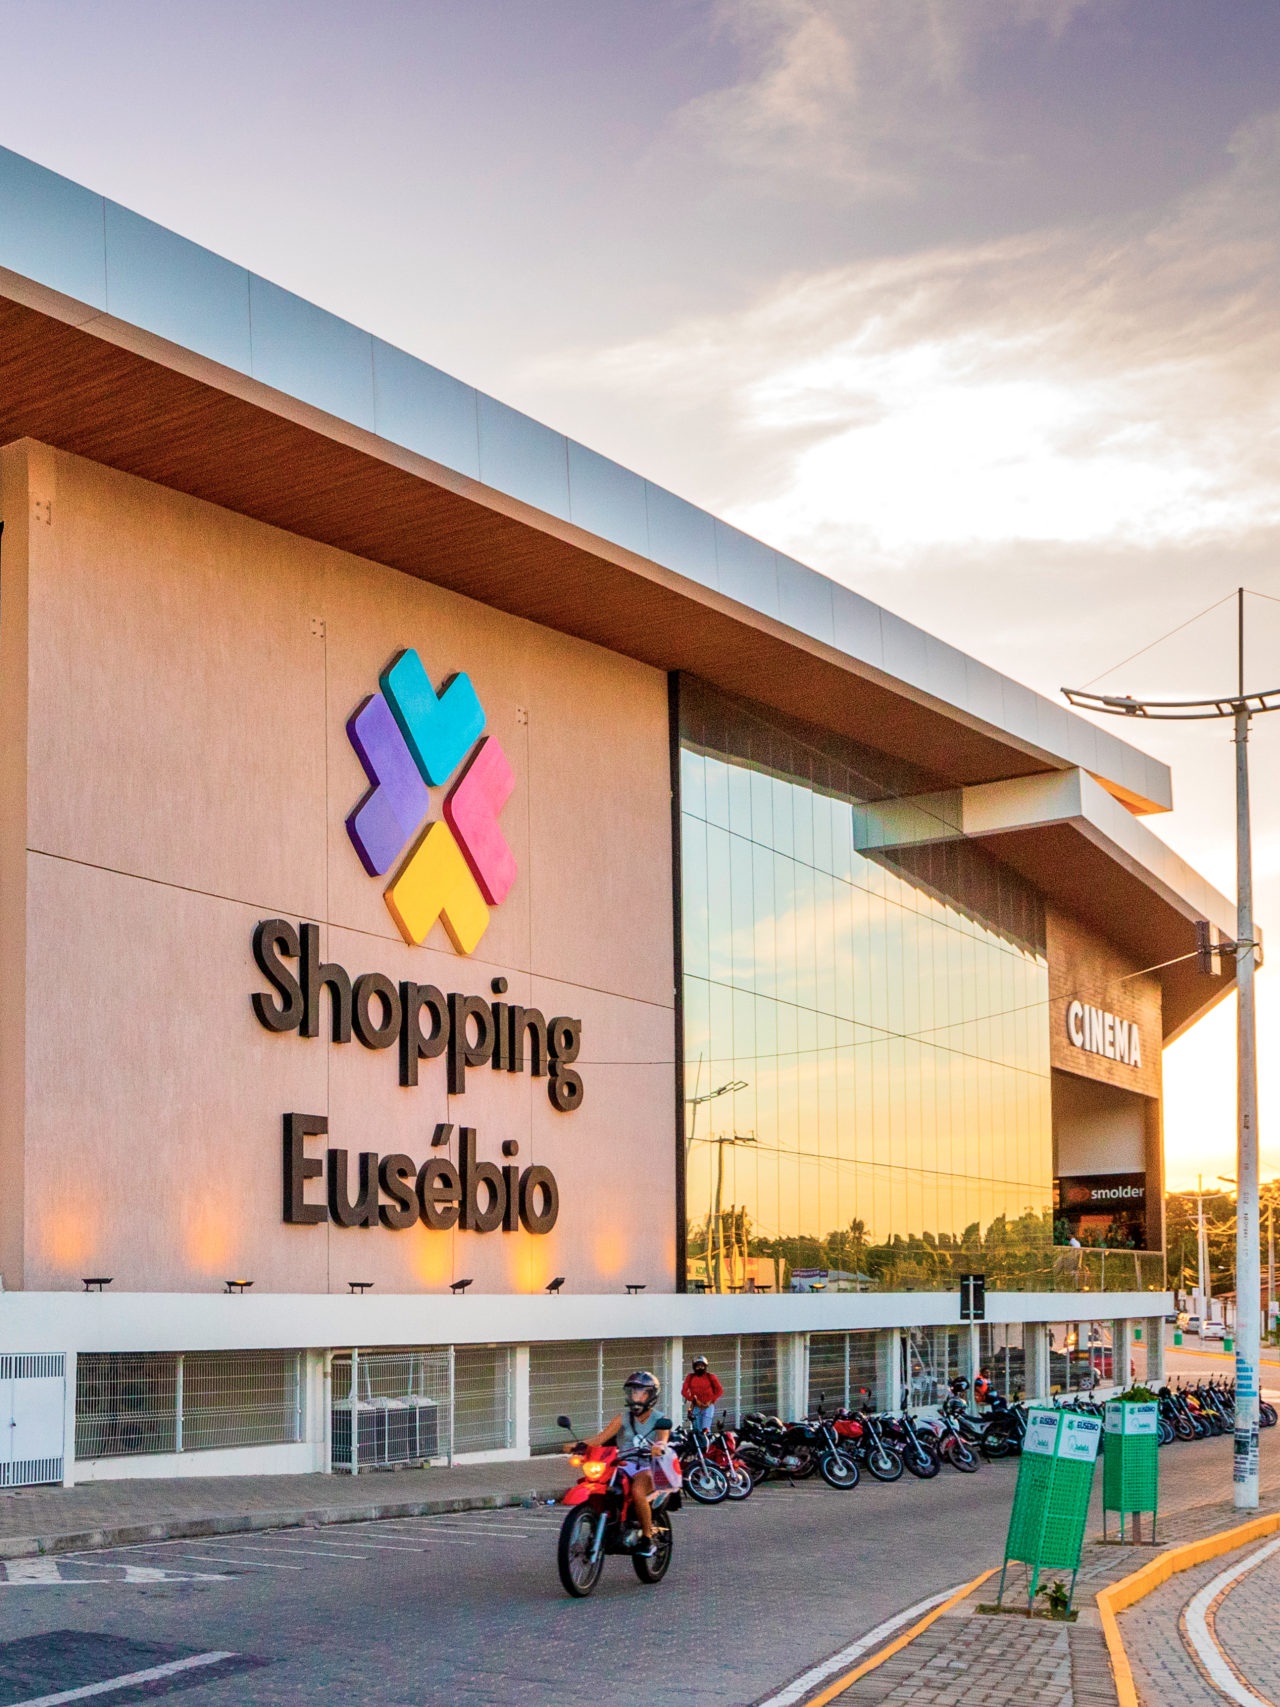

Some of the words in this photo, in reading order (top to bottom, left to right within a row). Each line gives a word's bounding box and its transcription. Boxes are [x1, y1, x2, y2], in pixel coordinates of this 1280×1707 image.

[251, 919, 584, 1112] Shopping
[1068, 1000, 1142, 1068] CINEMA
[282, 1112, 559, 1235] Eusébio
[1091, 1186, 1145, 1200] smolder
